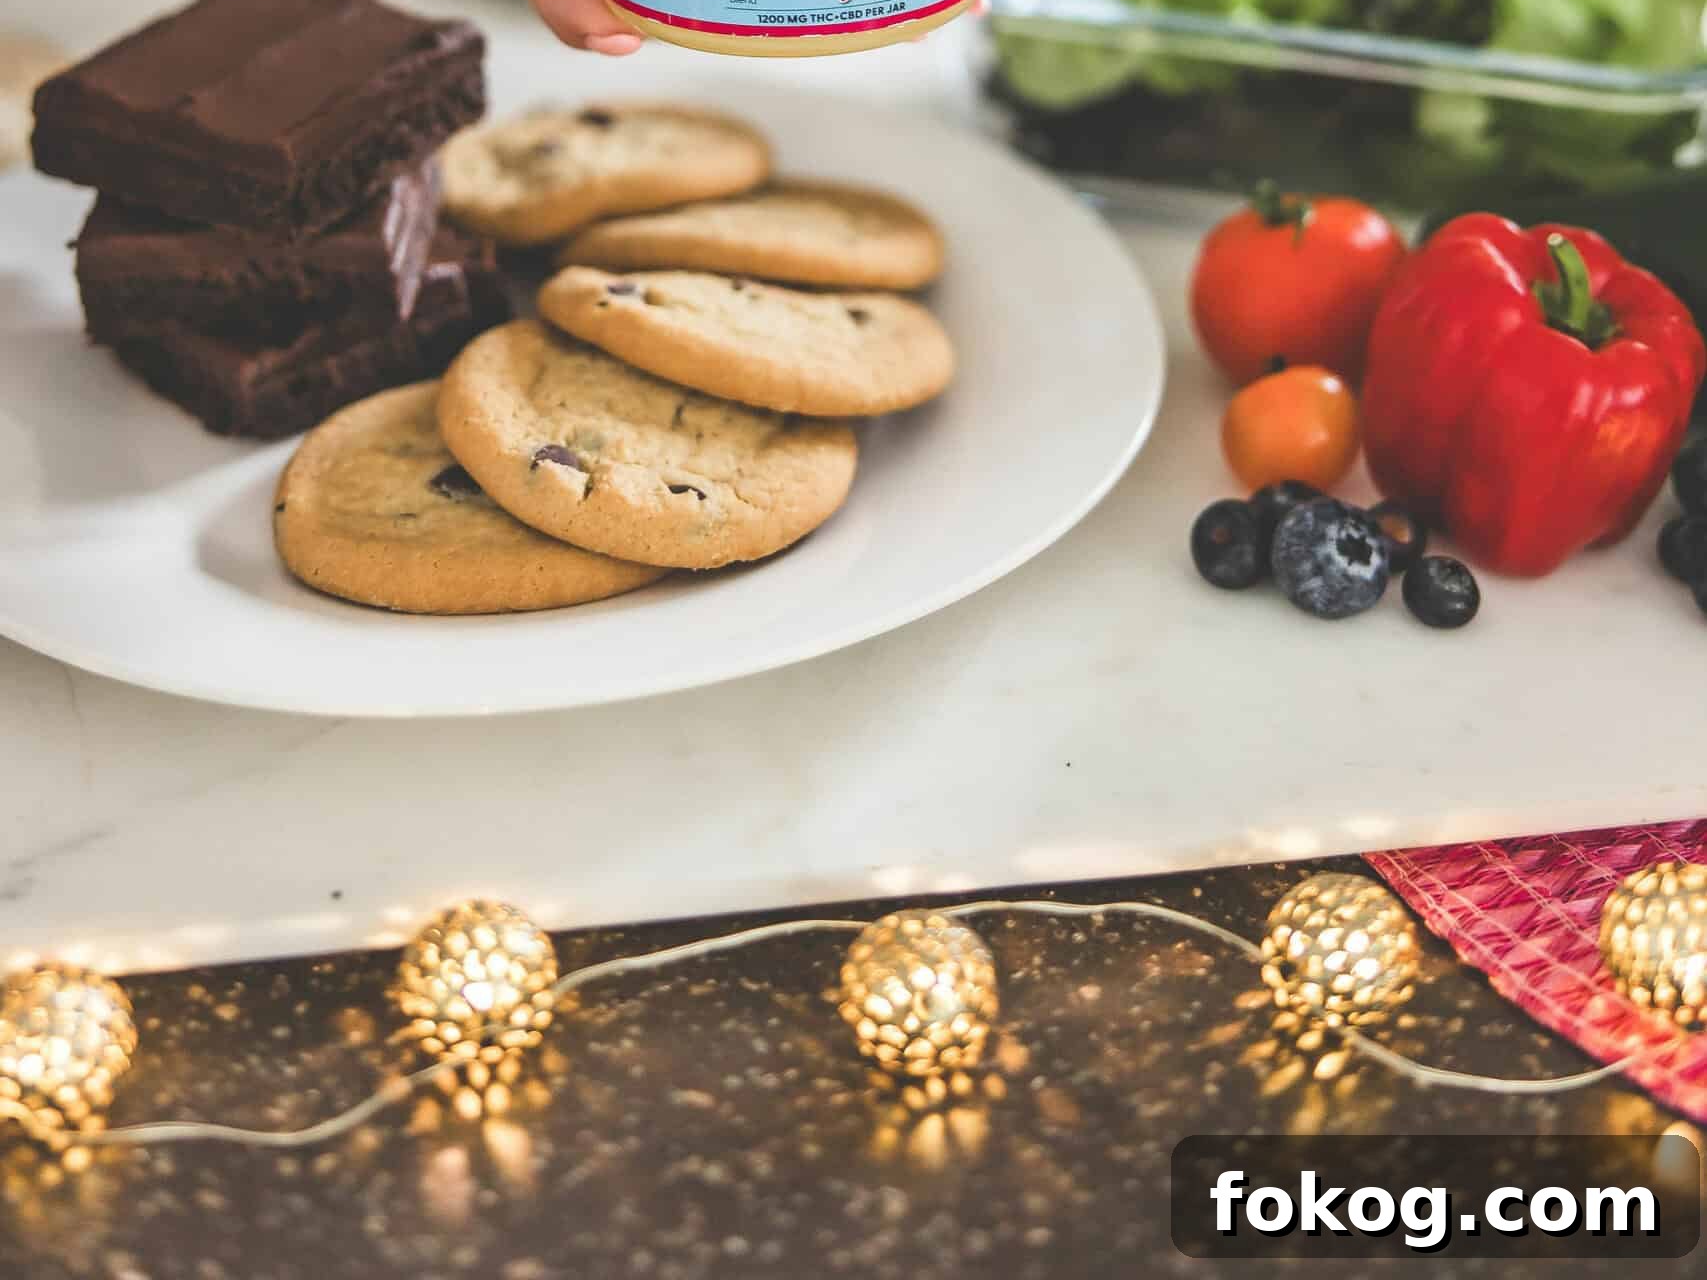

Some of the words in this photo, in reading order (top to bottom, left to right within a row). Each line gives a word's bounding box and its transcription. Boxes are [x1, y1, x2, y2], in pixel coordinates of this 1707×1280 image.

[757, 14, 785, 24] 1200
[787, 14, 809, 24] MG
[865, 6, 885, 18] PER
[887, 2, 906, 14] JAR
